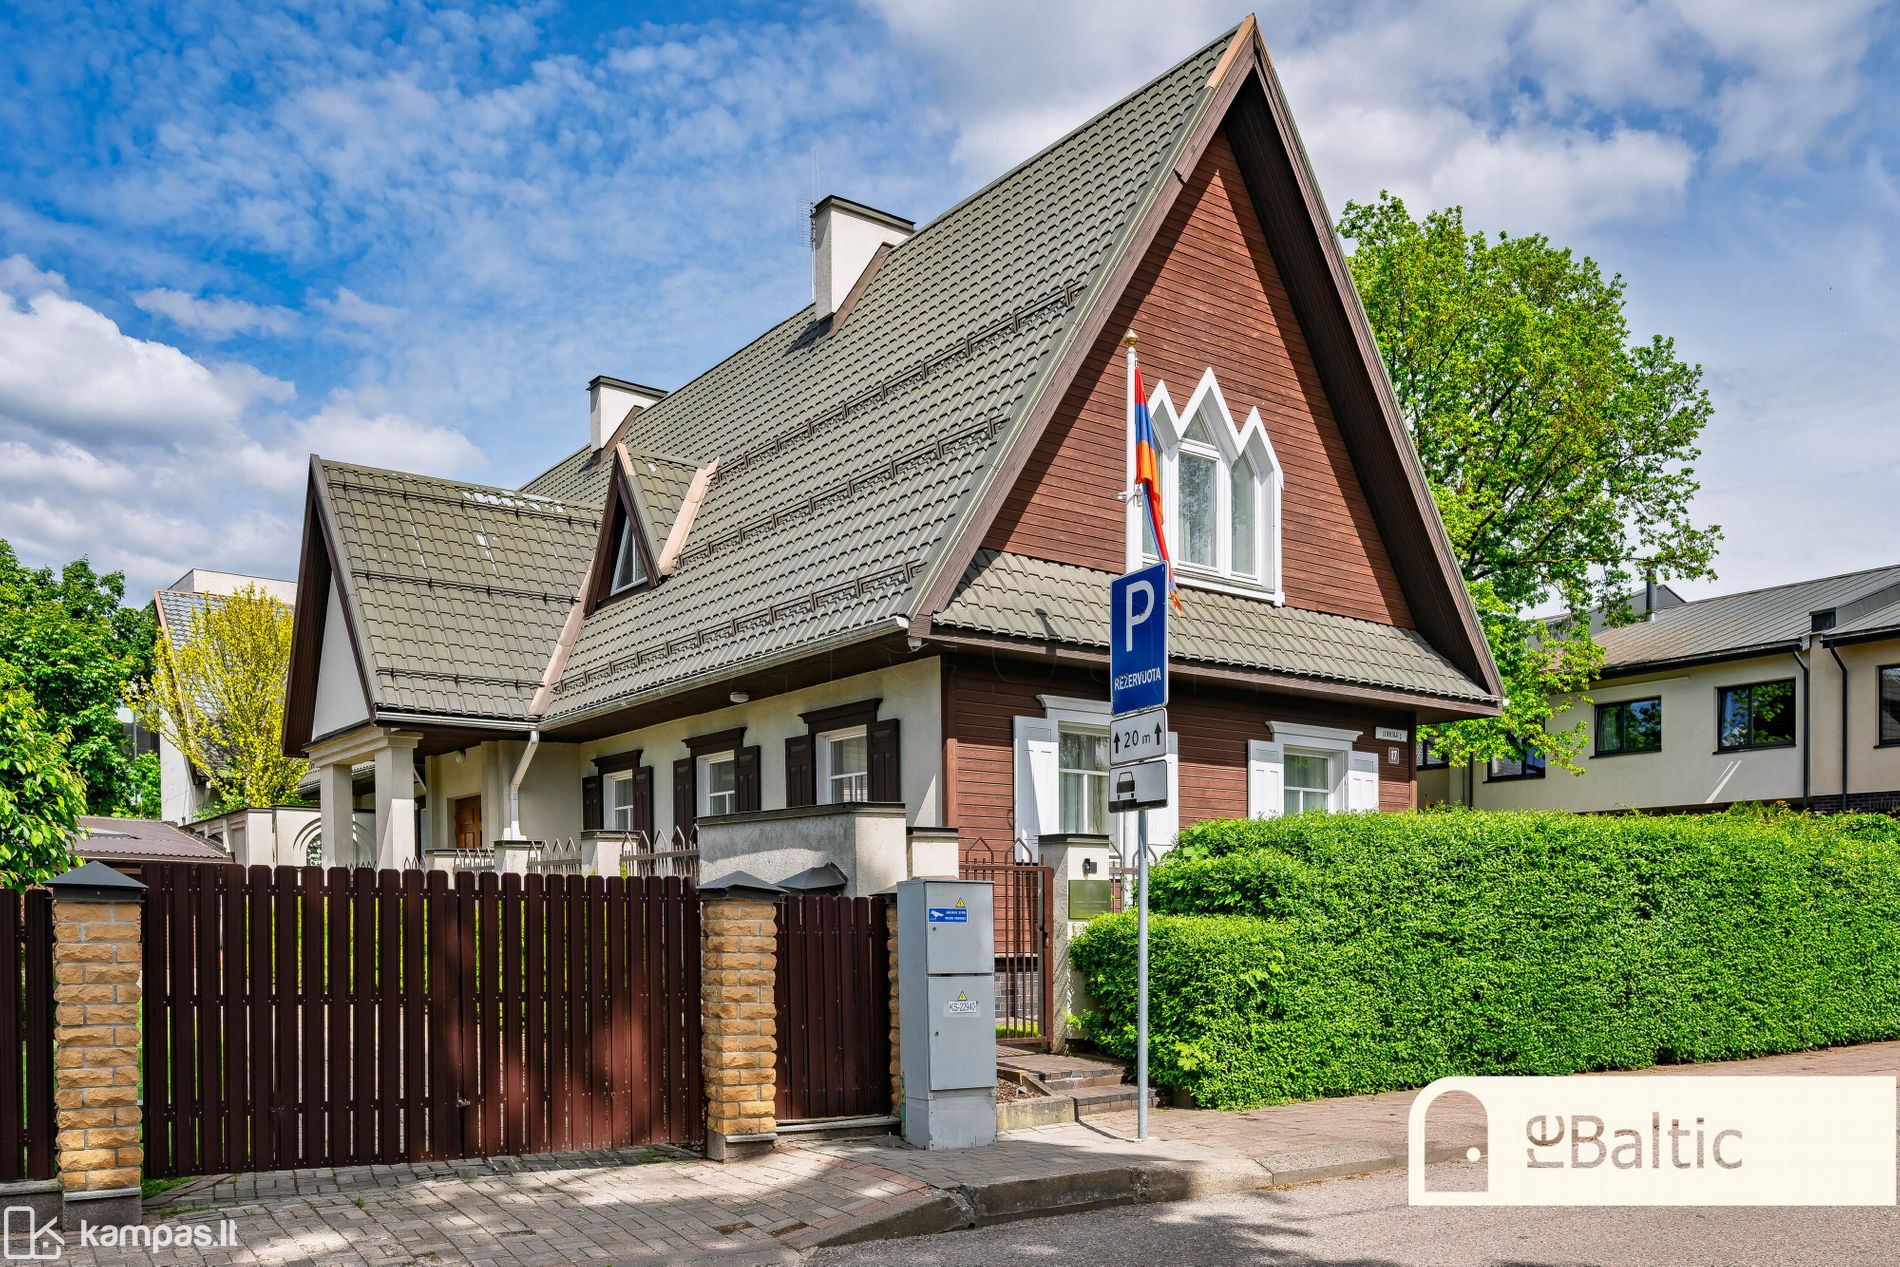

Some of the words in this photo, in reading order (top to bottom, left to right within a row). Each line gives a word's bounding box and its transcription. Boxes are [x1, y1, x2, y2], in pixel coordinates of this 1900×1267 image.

[1126, 580, 1155, 652] P
[1114, 667, 1162, 691] REZERVUOTA
[1124, 729, 1139, 749] 20
[1142, 733, 1151, 746] m
[1391, 750, 1398, 761] 17
